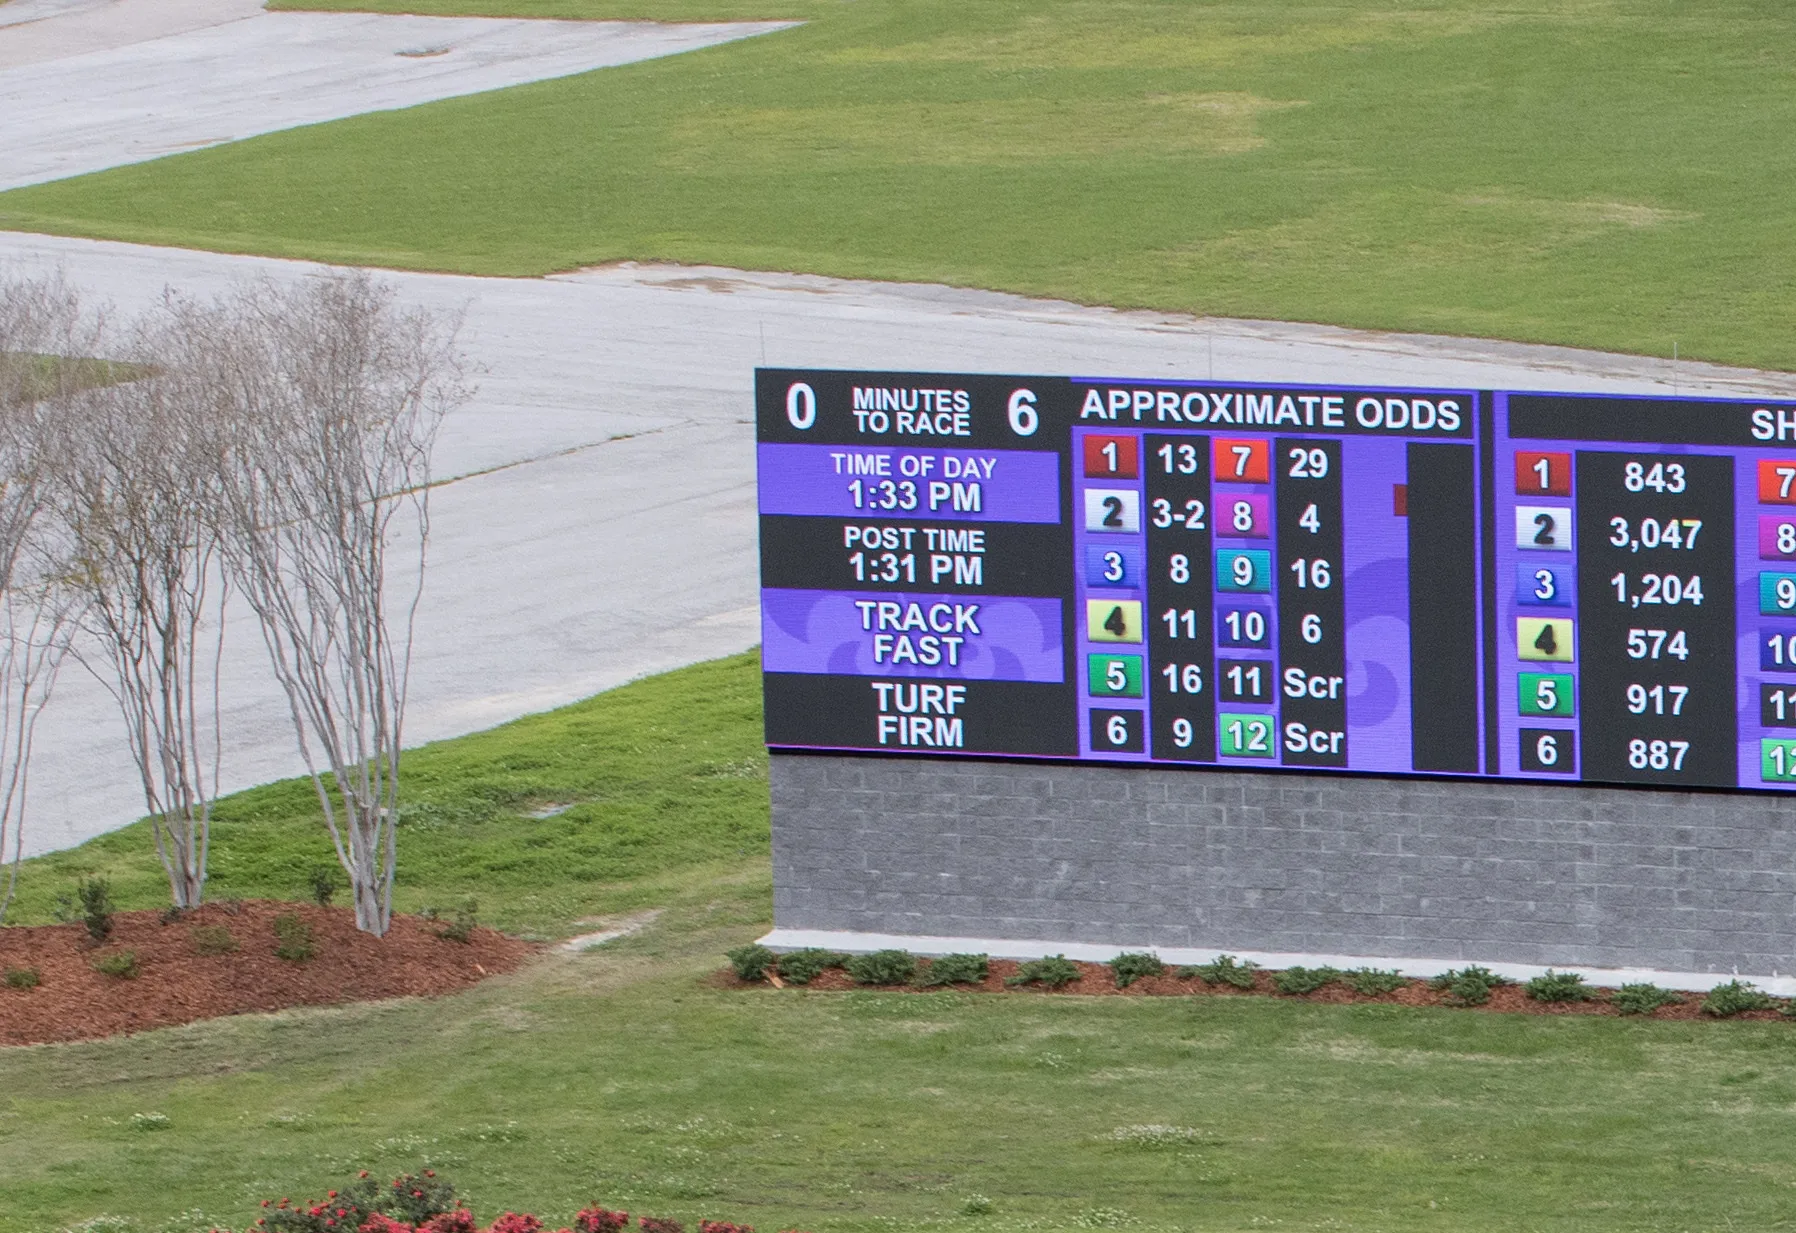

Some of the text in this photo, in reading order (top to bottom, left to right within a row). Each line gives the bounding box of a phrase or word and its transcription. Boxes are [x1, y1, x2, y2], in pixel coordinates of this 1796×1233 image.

[786, 382, 816, 429] 0
[853, 387, 970, 413] MINUTES
[1007, 388, 1038, 436] 6
[1080, 389, 1460, 430] APPROXIMATE ODDS
[852, 409, 971, 436] TO RACE
[829, 452, 997, 479] TIME OF DAY
[1102, 441, 1197, 474] 1 13
[1231, 446, 1328, 478] 7 29
[1533, 458, 1686, 493] 1 843
[1776, 467, 1796, 498] 7
[847, 479, 981, 512] 1:33 PM
[1102, 496, 1205, 529] 2 3-2
[1233, 501, 1321, 533] 8 4
[844, 525, 985, 552] POST TIME
[1534, 513, 1702, 553] 2 3,047
[1777, 523, 1796, 553] 8
[849, 551, 982, 585] 1:31 PM
[1104, 551, 1189, 583] 3 8
[1232, 556, 1330, 589] 9 16
[1534, 569, 1704, 608] 3 1,204
[1776, 578, 1796, 609] 9
[854, 600, 980, 634] TRACK
[1104, 606, 1195, 639] 4 11
[1225, 611, 1321, 643] 10 6
[874, 634, 964, 665] FAST
[1534, 624, 1689, 661] 4 574
[1106, 660, 1202, 693] 5 16
[1227, 665, 1343, 699] 11 Scr
[871, 682, 966, 715] TURF
[1536, 679, 1689, 715] 5 917
[878, 715, 963, 747] FIRM
[1107, 715, 1192, 747] 6 9
[1227, 720, 1344, 754] 12 Scr
[1537, 735, 1689, 771] 6 887
